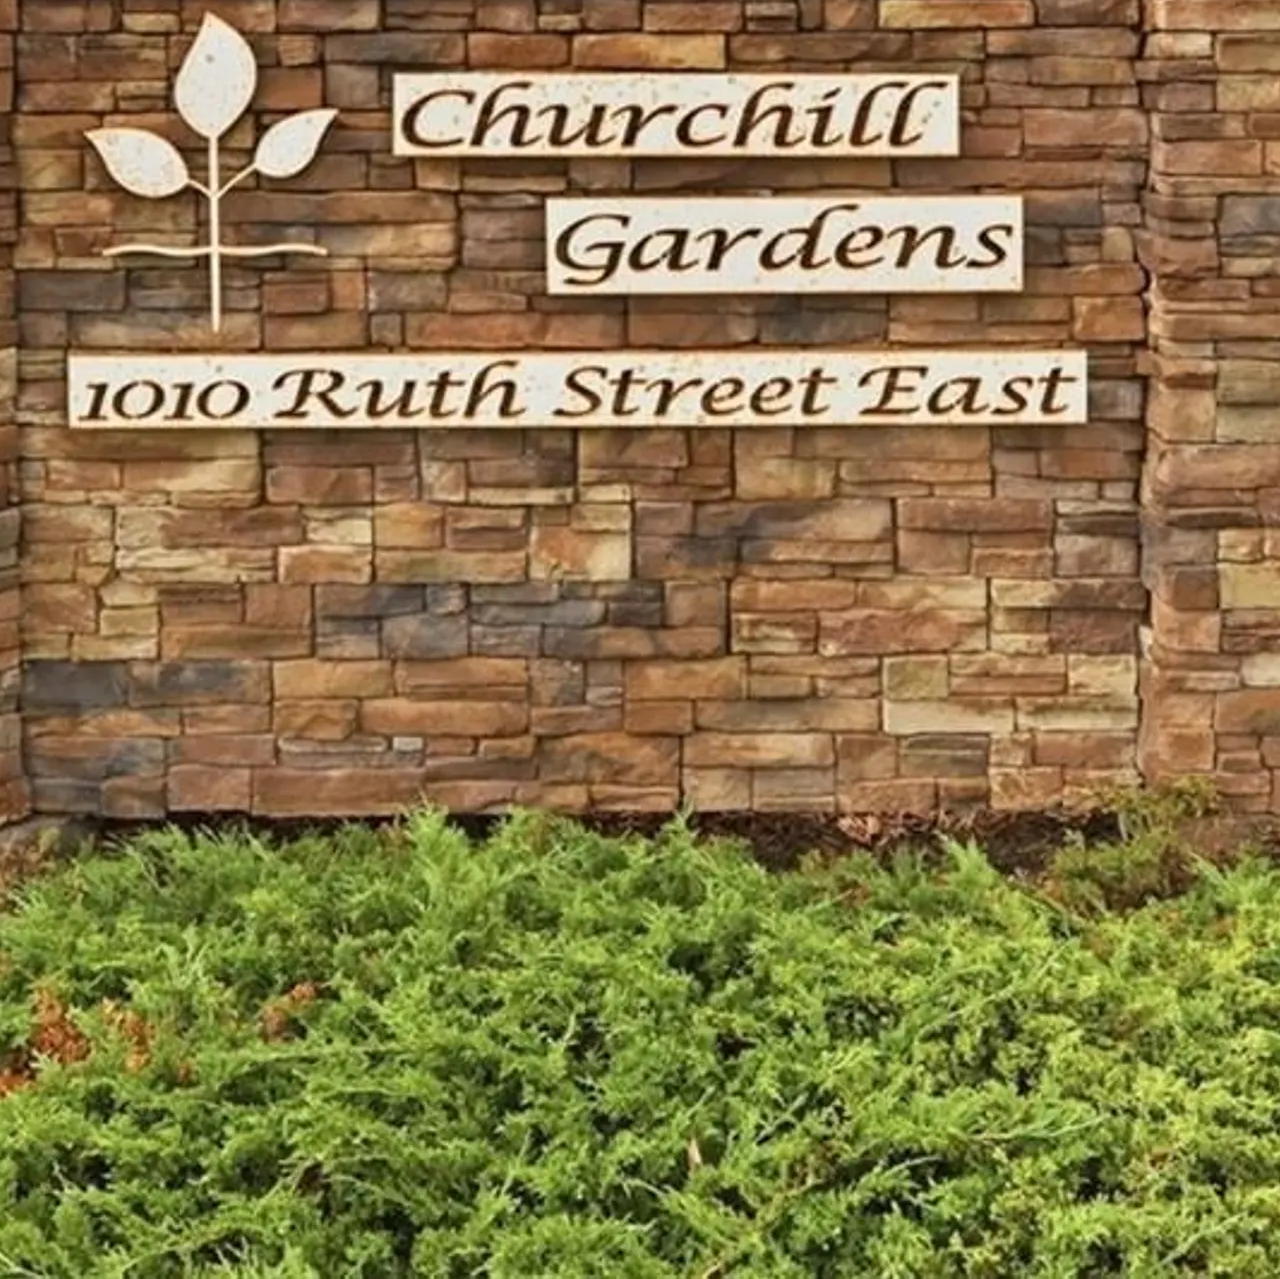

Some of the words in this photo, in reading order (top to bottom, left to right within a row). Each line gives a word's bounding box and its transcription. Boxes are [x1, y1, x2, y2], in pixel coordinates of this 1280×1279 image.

[400, 79, 949, 150] Churchill
[554, 203, 1015, 287] Gardens
[77, 379, 252, 421] 1010
[271, 359, 527, 420] Ruth
[552, 366, 838, 419] Street
[858, 365, 1078, 417] East
